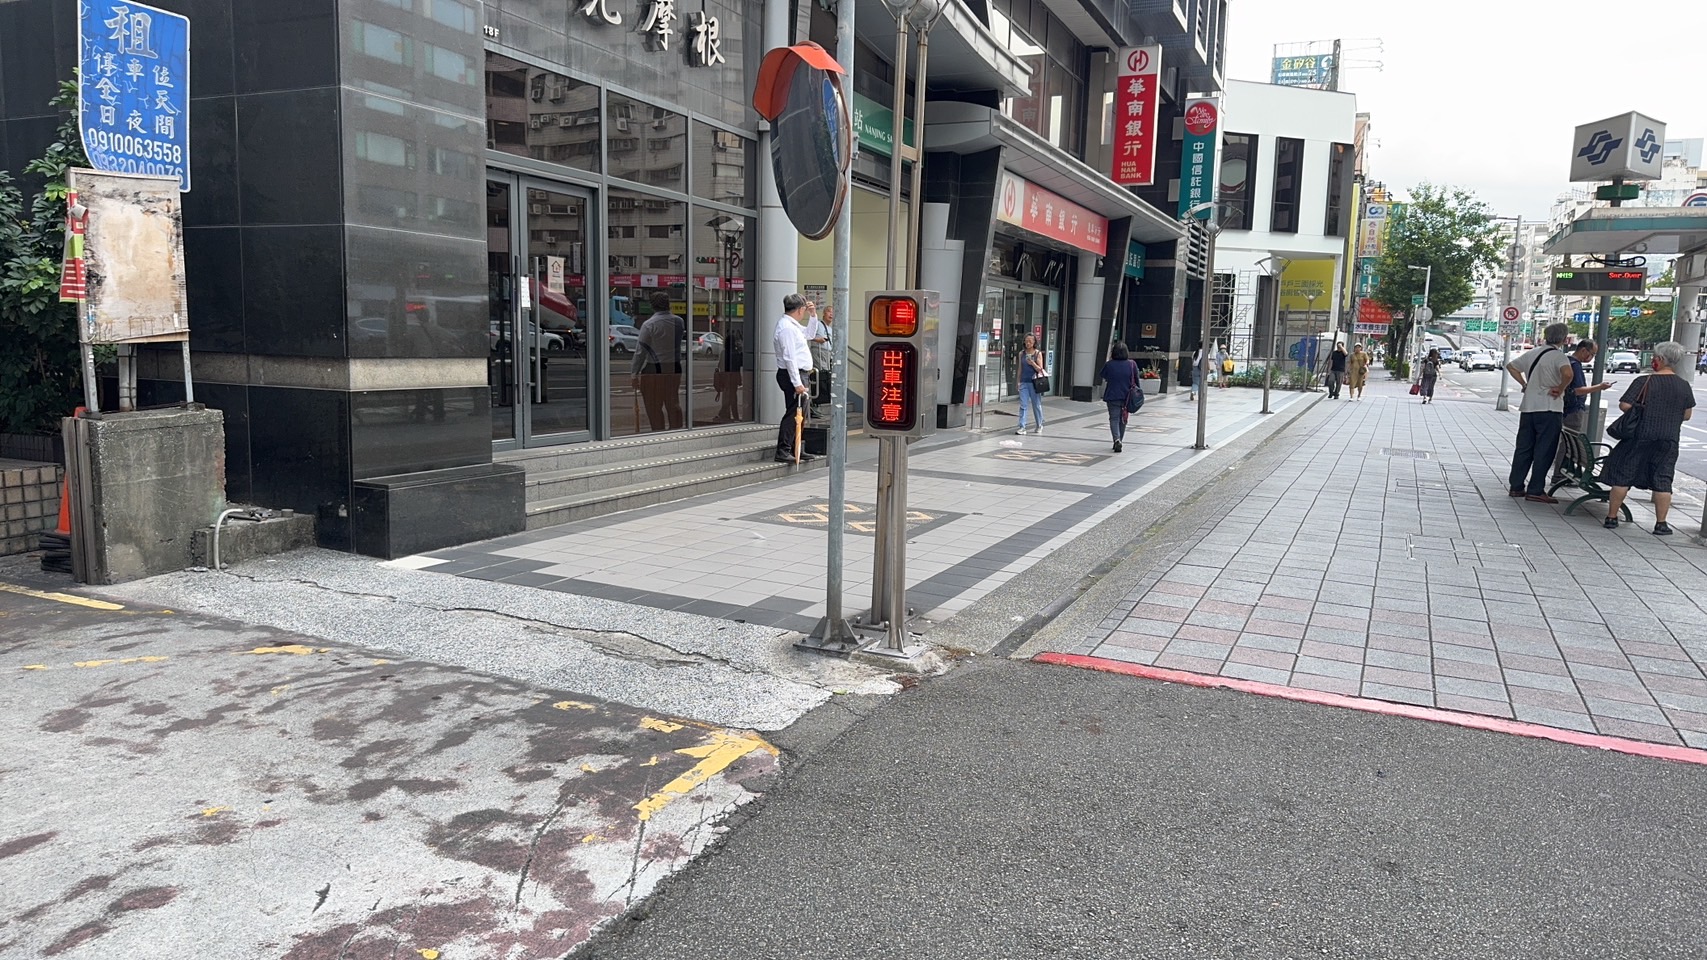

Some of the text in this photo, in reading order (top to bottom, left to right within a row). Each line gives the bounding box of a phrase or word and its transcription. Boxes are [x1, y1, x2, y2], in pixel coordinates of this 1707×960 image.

[104, 5, 159, 59] 租
[483, 24, 500, 38] 18F
[854, 108, 863, 131] 站
[864, 124, 886, 141] NANJING
[1123, 78, 1146, 157] 華南銀行
[88, 128, 182, 164] 0910063558
[1030, 193, 1078, 236] 華南銀行
[880, 350, 903, 422] 出車注意
